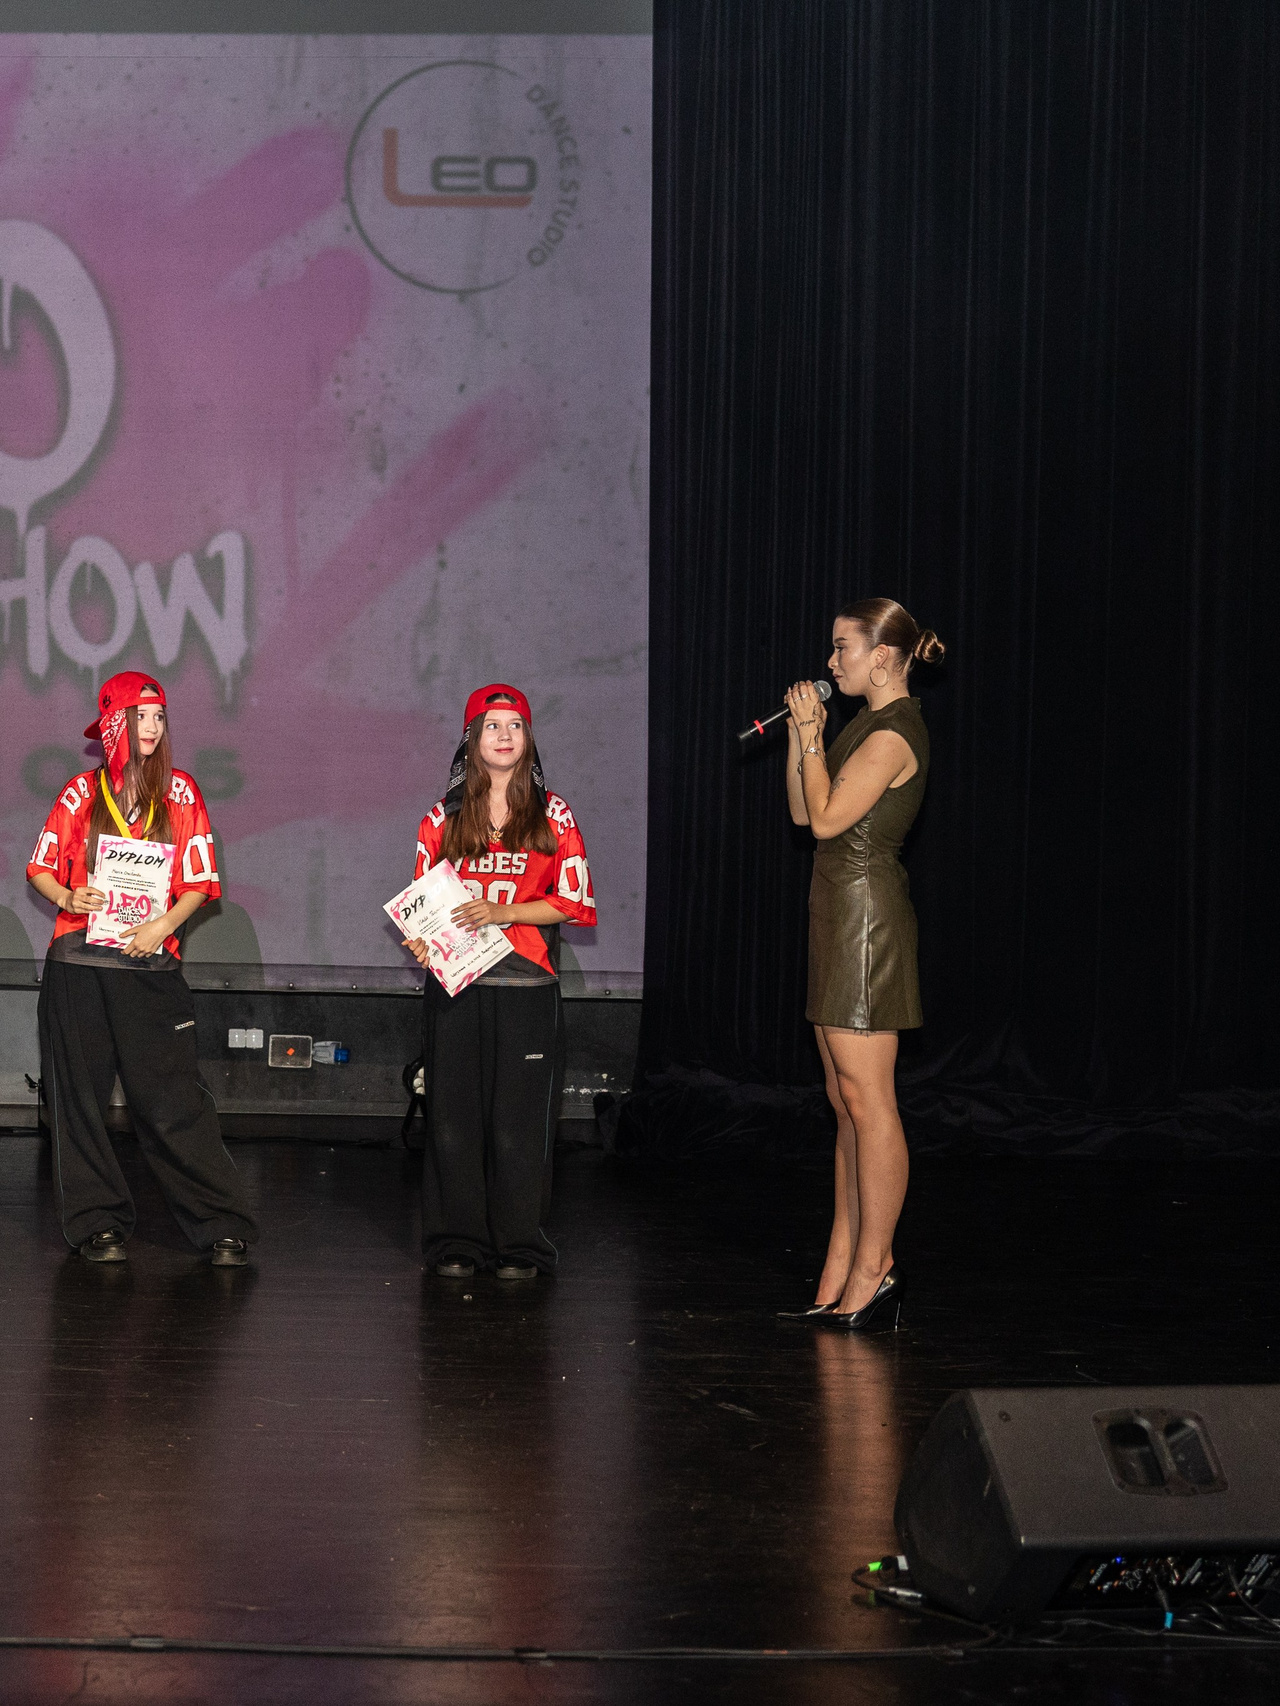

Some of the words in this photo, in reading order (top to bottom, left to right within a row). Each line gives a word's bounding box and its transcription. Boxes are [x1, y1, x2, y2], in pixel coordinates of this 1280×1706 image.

[382, 127, 537, 208] LEO
[526, 84, 579, 172] DANCE
[527, 179, 580, 267] STUDIO
[105, 849, 166, 869] DYPLOM
[106, 890, 151, 919] LEO
